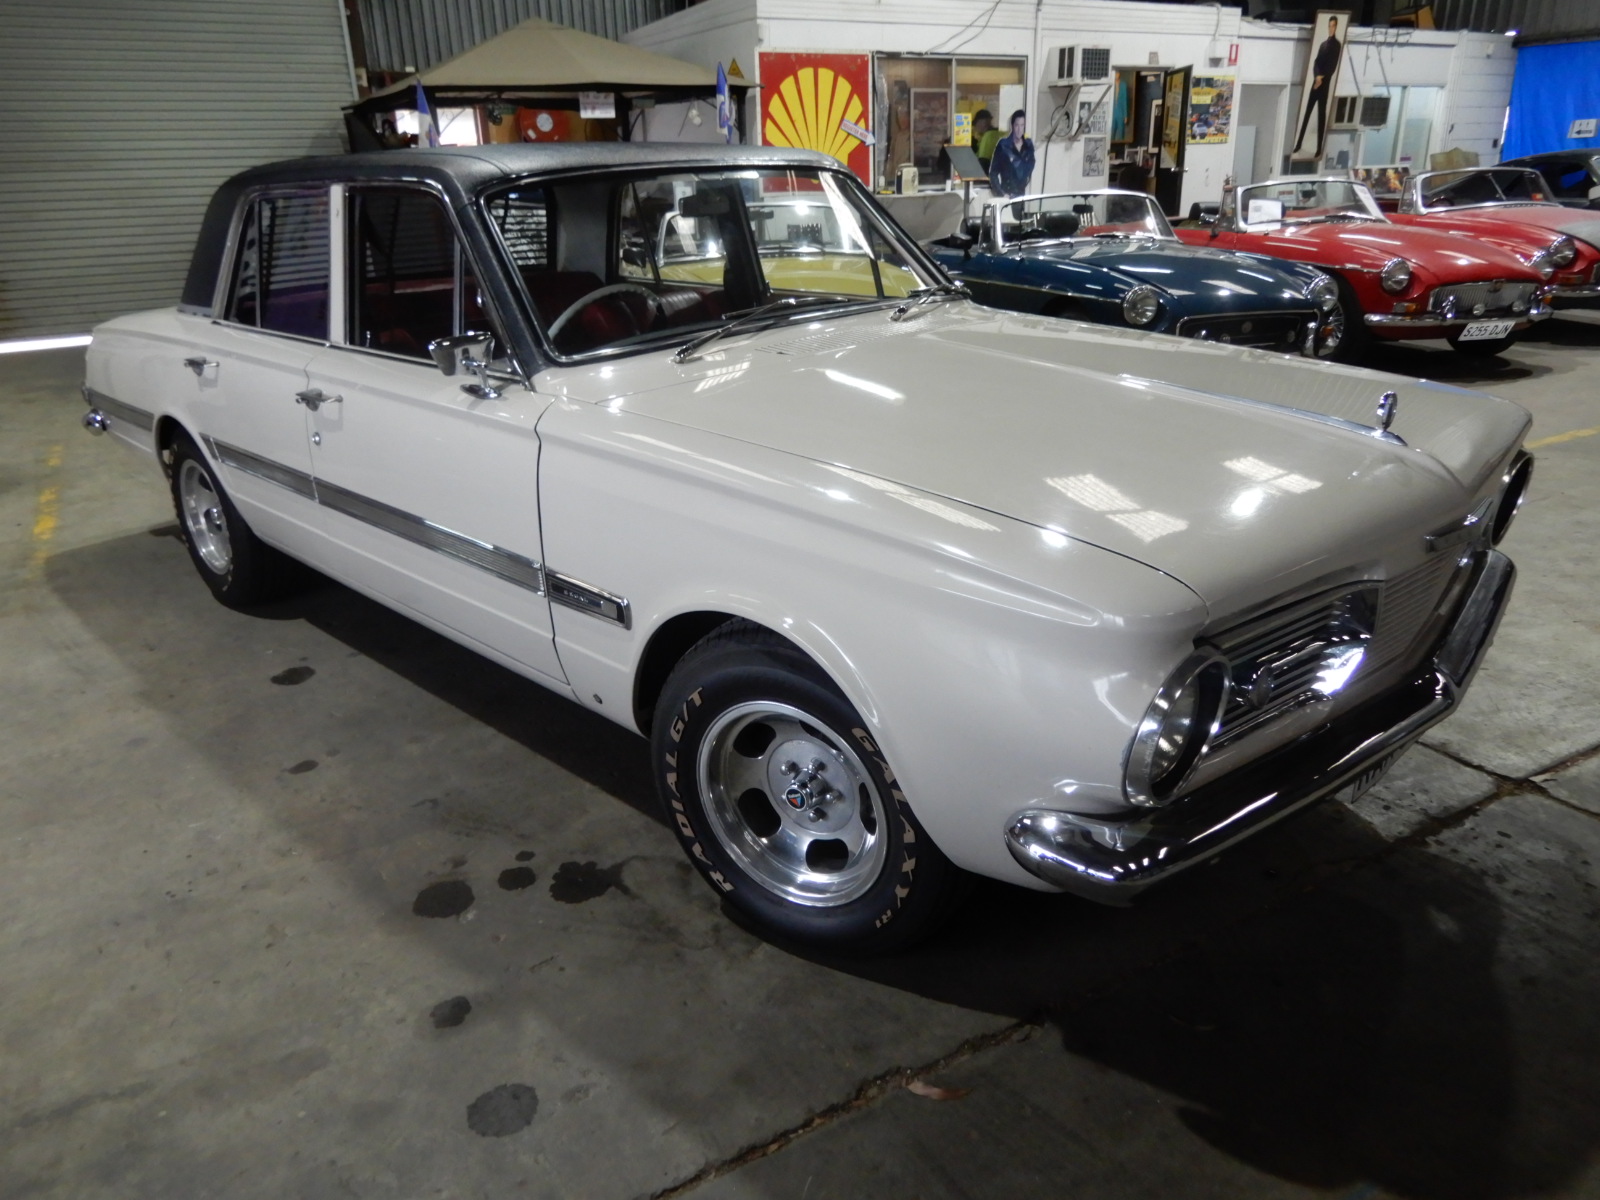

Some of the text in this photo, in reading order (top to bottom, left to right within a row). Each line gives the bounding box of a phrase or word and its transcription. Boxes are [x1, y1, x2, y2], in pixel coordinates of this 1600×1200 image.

[1463, 324, 1512, 337] S255 DJN
[665, 686, 735, 893] RADIAL G/T
[851, 727, 916, 909] GALAXY
